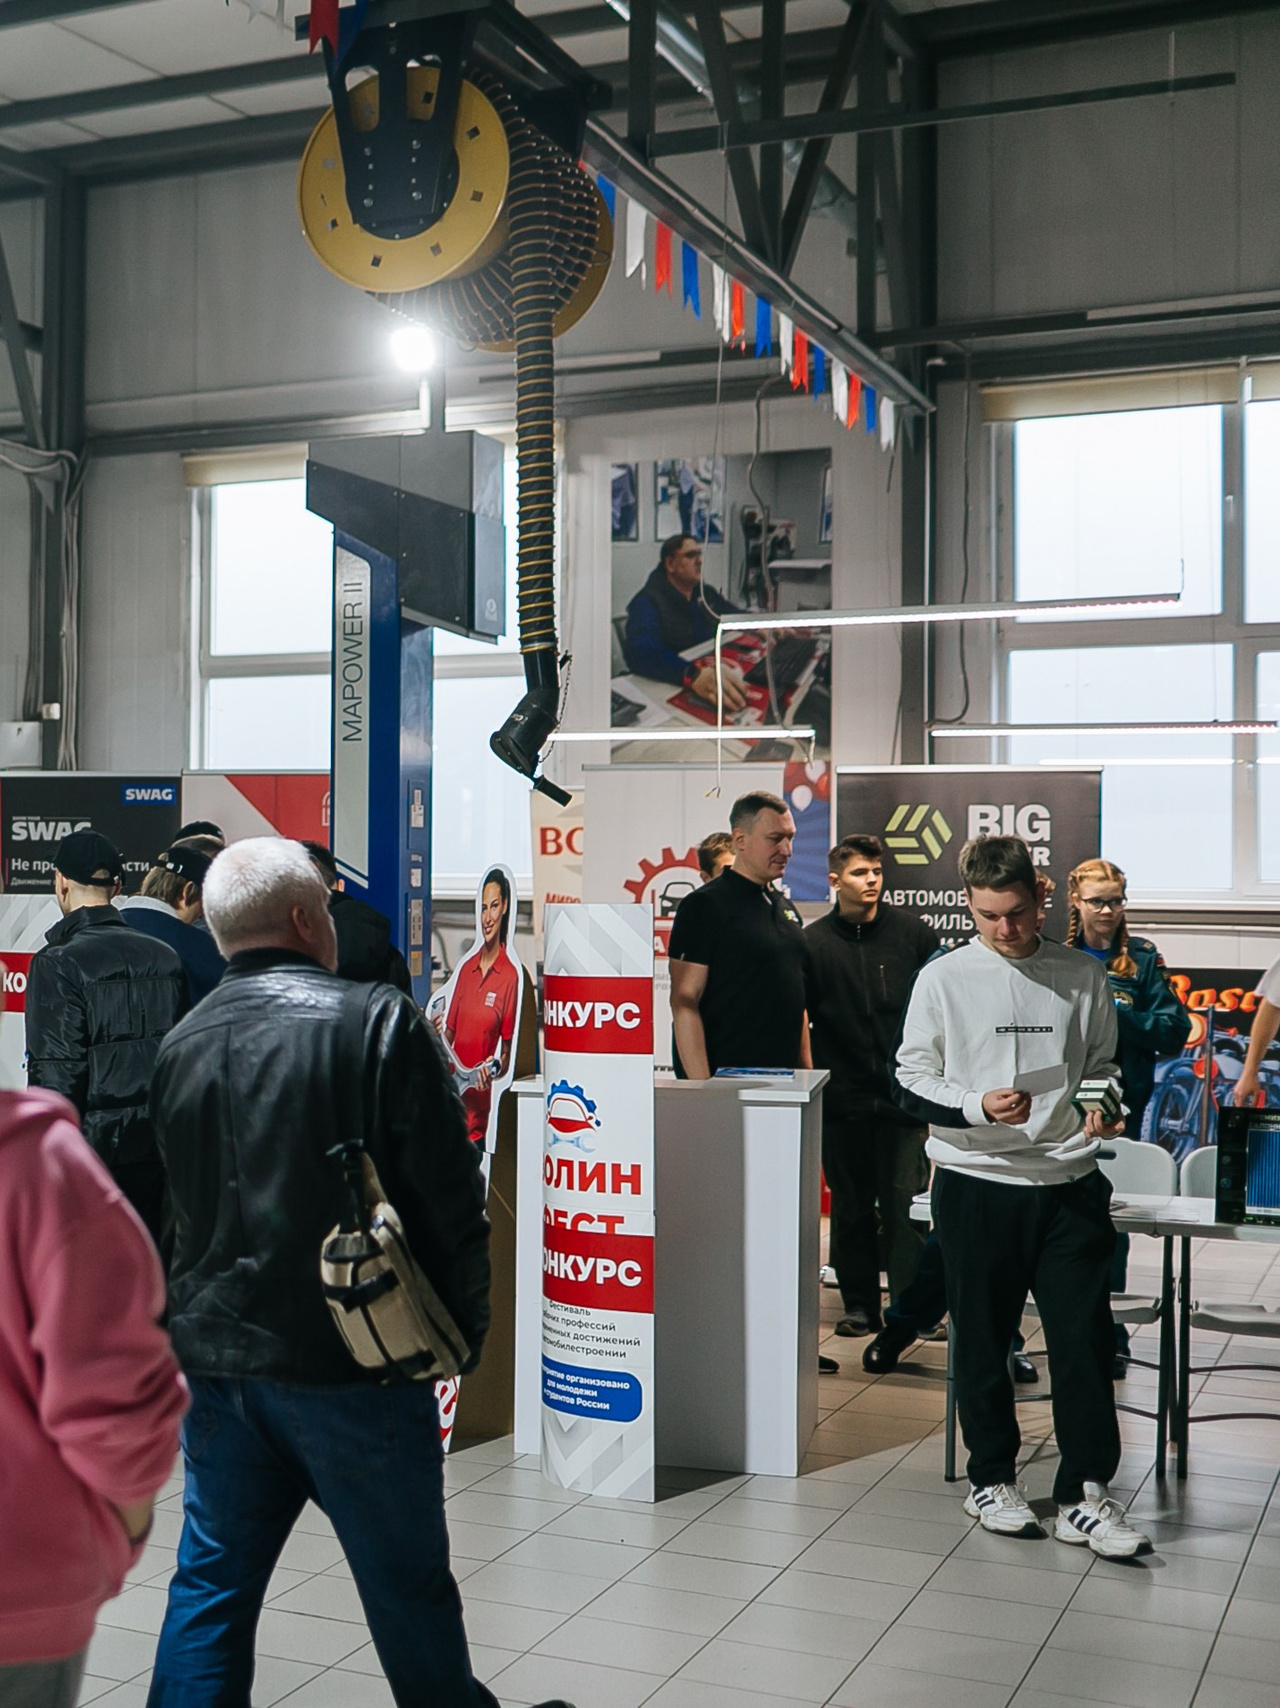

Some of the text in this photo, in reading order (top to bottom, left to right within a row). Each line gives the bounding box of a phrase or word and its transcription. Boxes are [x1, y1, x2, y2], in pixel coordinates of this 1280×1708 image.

[342, 582, 363, 741] MAPOWER II
[125, 788, 173, 801] SWAG
[968, 804, 1051, 843] BIG
[11, 858, 30, 870] Не
[544, 999, 641, 1029] ОНКУРС
[543, 1246, 642, 1287] ОНКУРС
[561, 1317, 616, 1332] профессий
[573, 1333, 641, 1347] достижений
[566, 1374, 630, 1389] организовано
[576, 1397, 610, 1410] России
